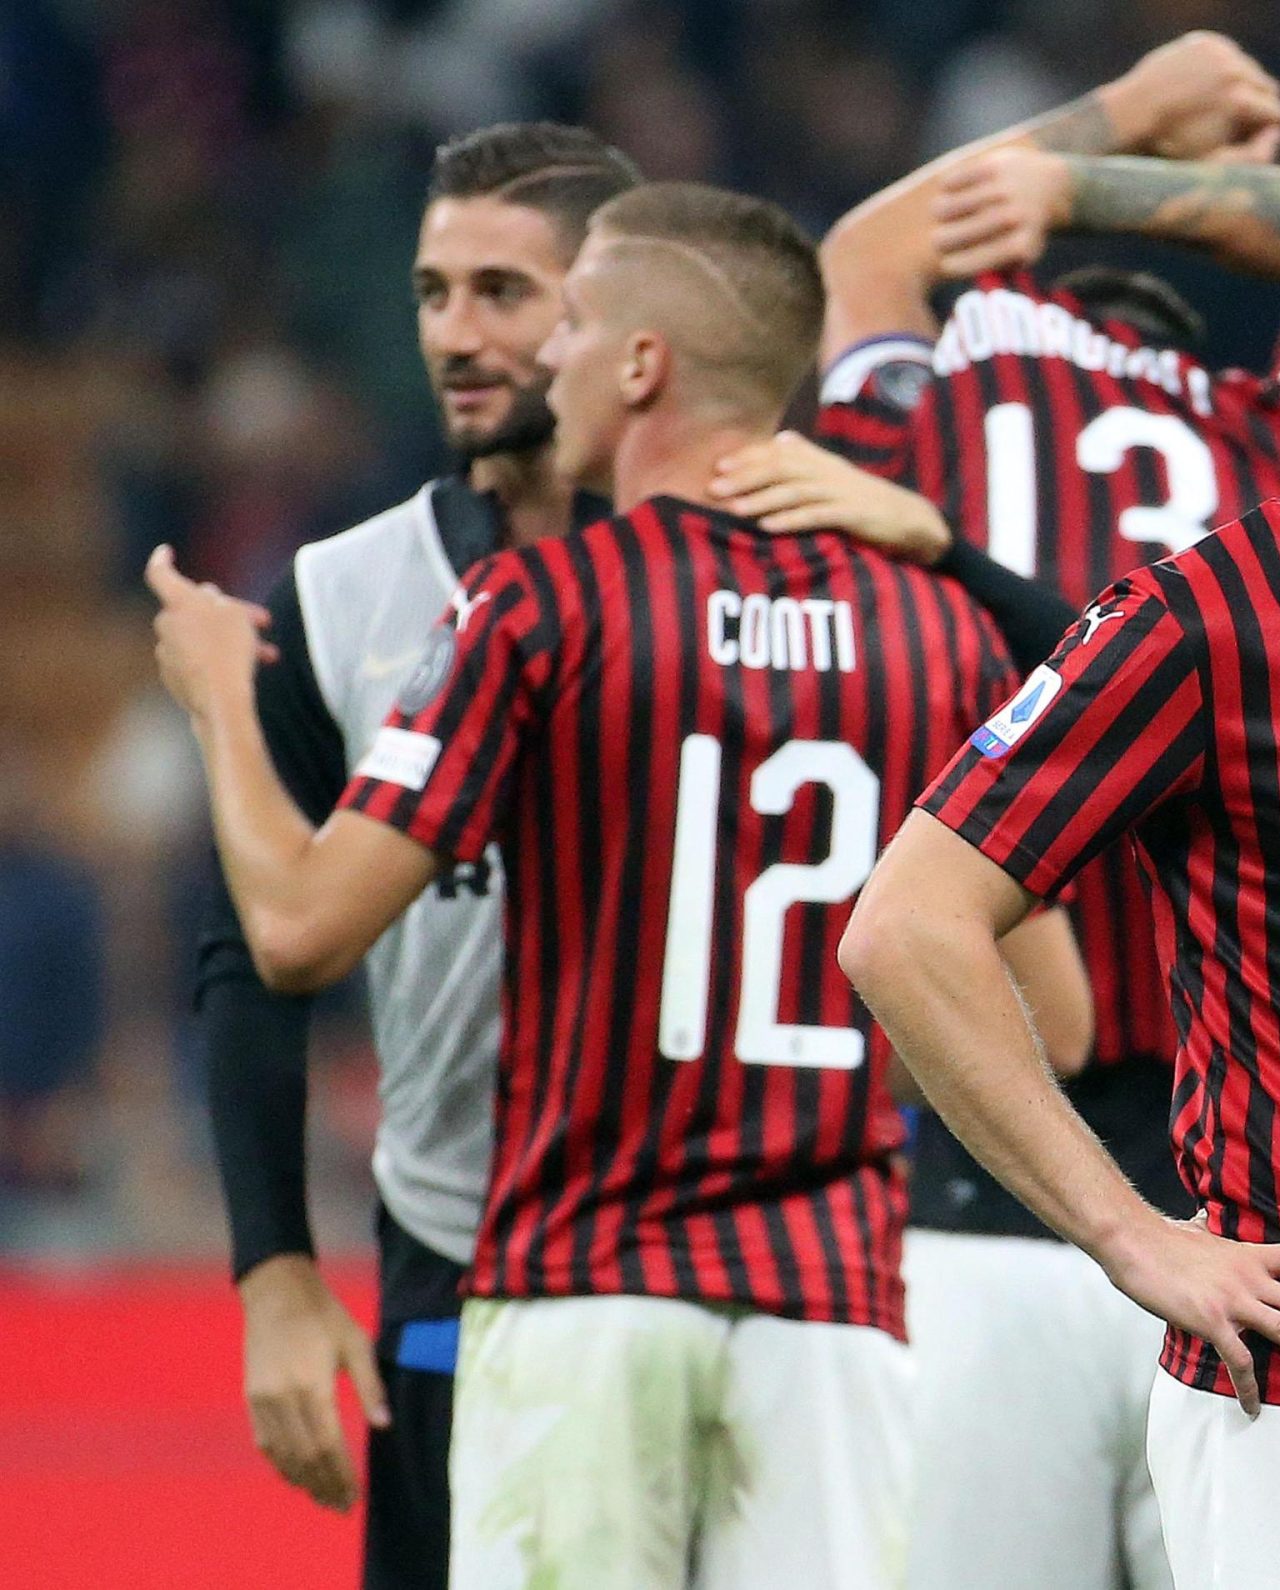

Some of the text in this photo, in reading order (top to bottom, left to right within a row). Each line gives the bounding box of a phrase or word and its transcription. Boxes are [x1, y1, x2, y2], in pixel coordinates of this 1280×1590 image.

[984, 401, 1219, 579] 13
[707, 590, 855, 673] CONTI
[658, 733, 881, 1070] 12
